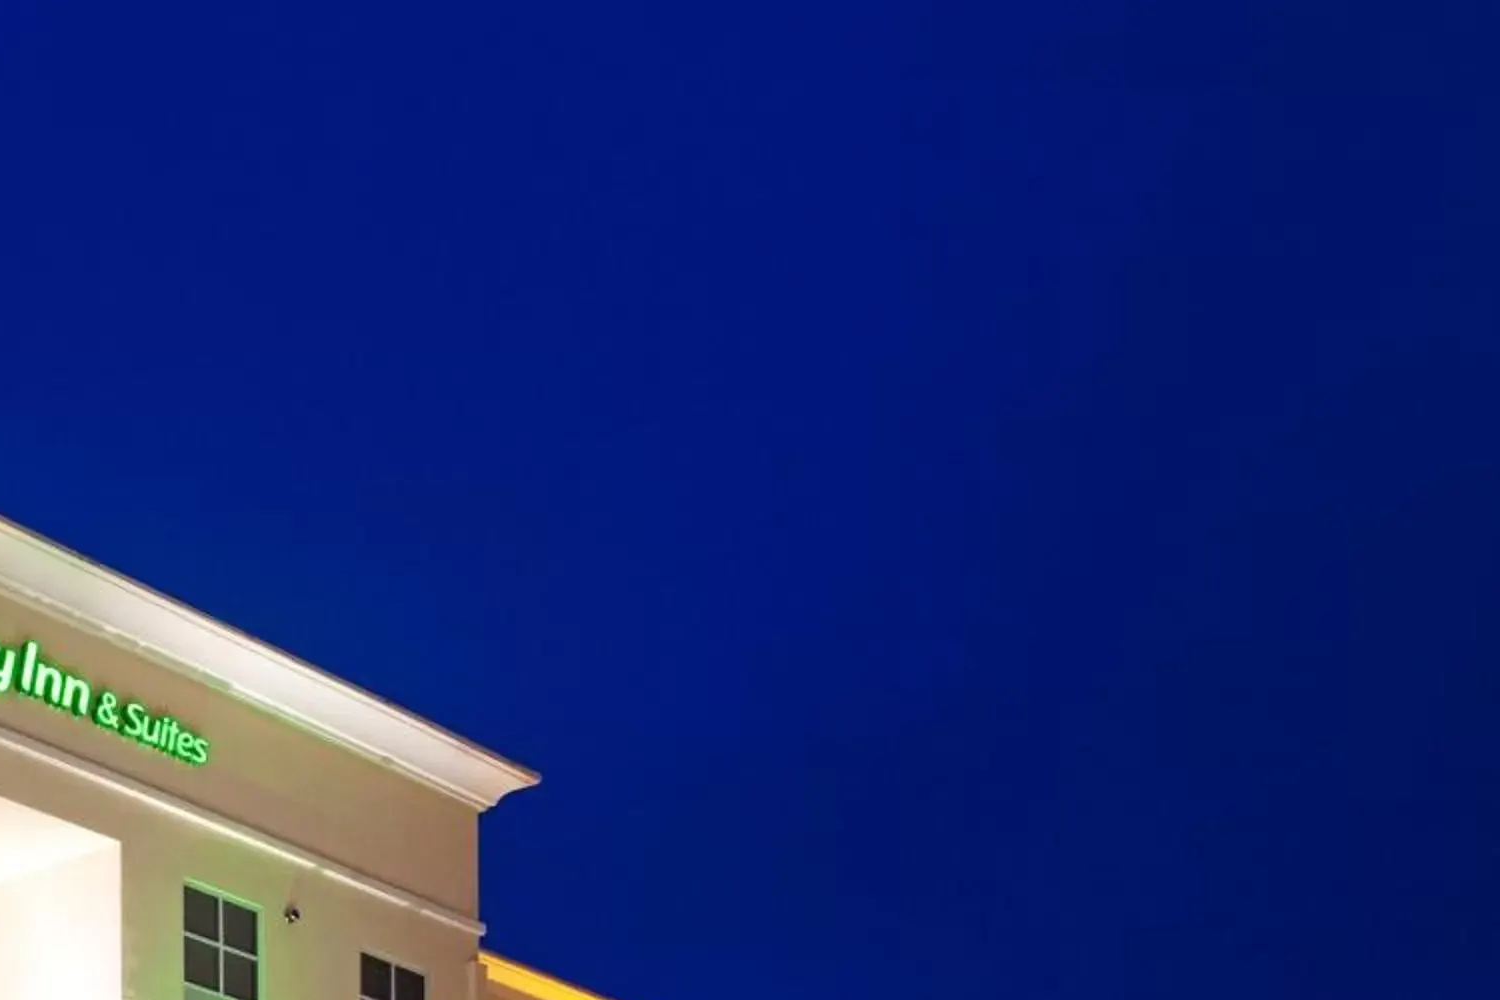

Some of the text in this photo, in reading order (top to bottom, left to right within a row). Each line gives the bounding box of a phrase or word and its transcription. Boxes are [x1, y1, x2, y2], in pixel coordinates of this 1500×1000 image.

[21, 641, 91, 715] Inn
[97, 692, 120, 729] &
[124, 703, 209, 764] Suites
